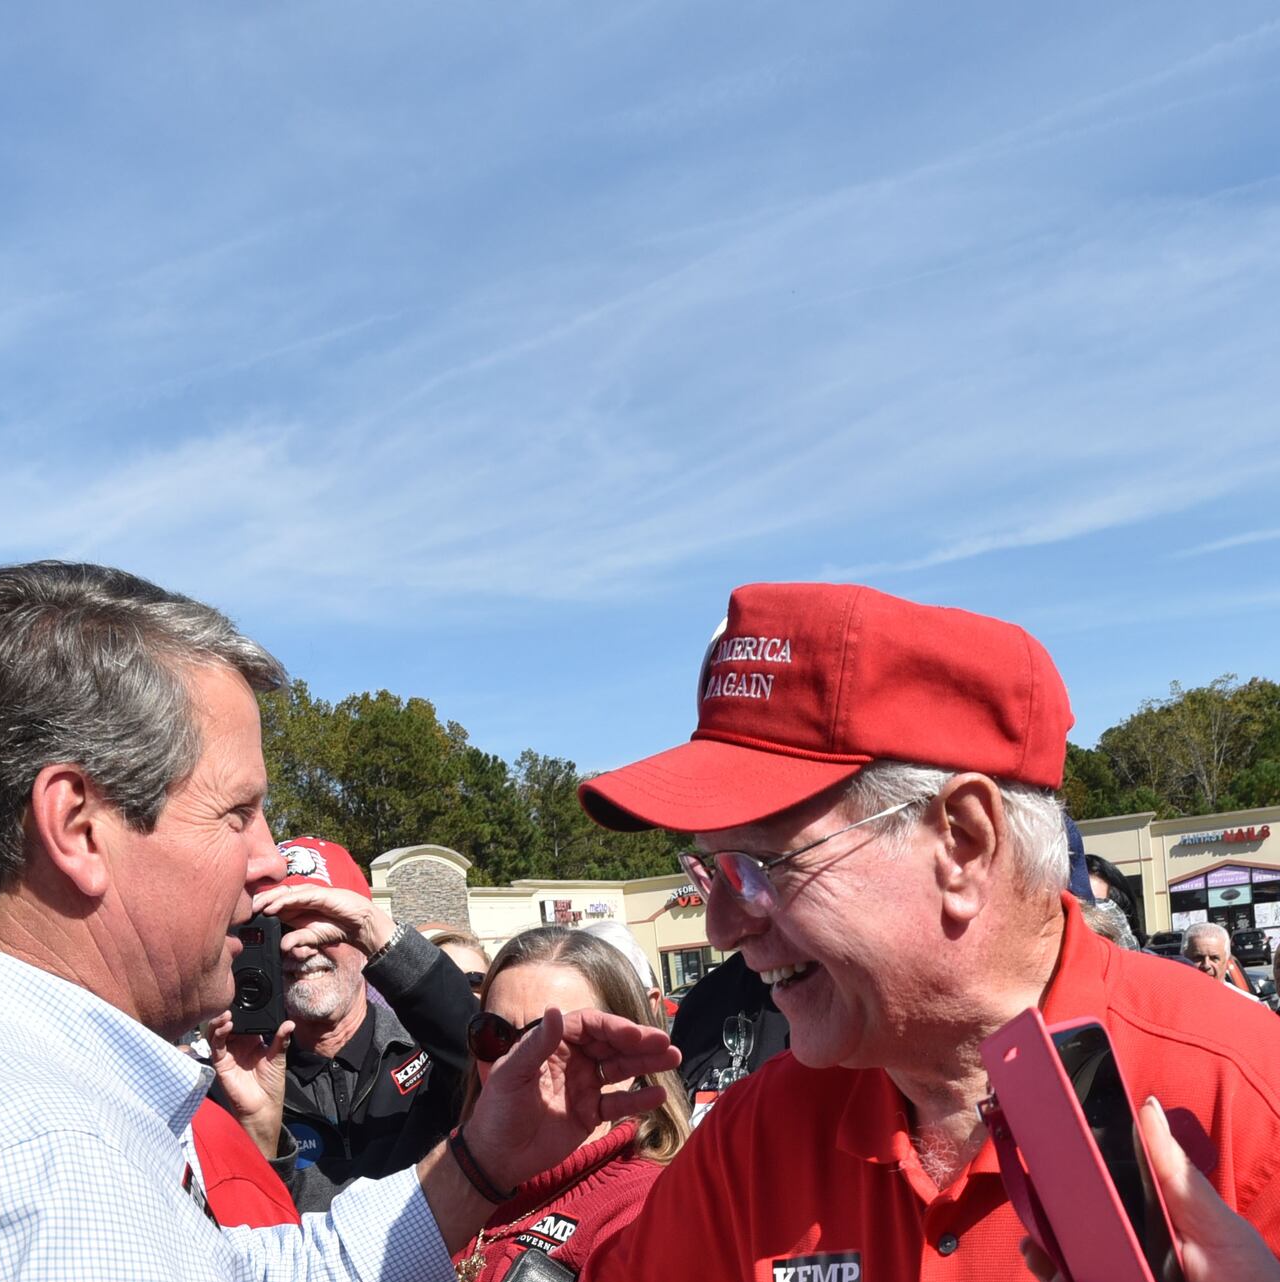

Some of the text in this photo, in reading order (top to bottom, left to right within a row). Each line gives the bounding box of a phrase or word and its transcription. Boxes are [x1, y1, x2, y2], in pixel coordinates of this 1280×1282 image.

[712, 672, 775, 700] AGAIN
[1223, 825, 1270, 843] NAILS
[395, 1051, 429, 1084] KEM
[297, 1139, 317, 1151] CAN
[530, 1215, 576, 1242] EMP
